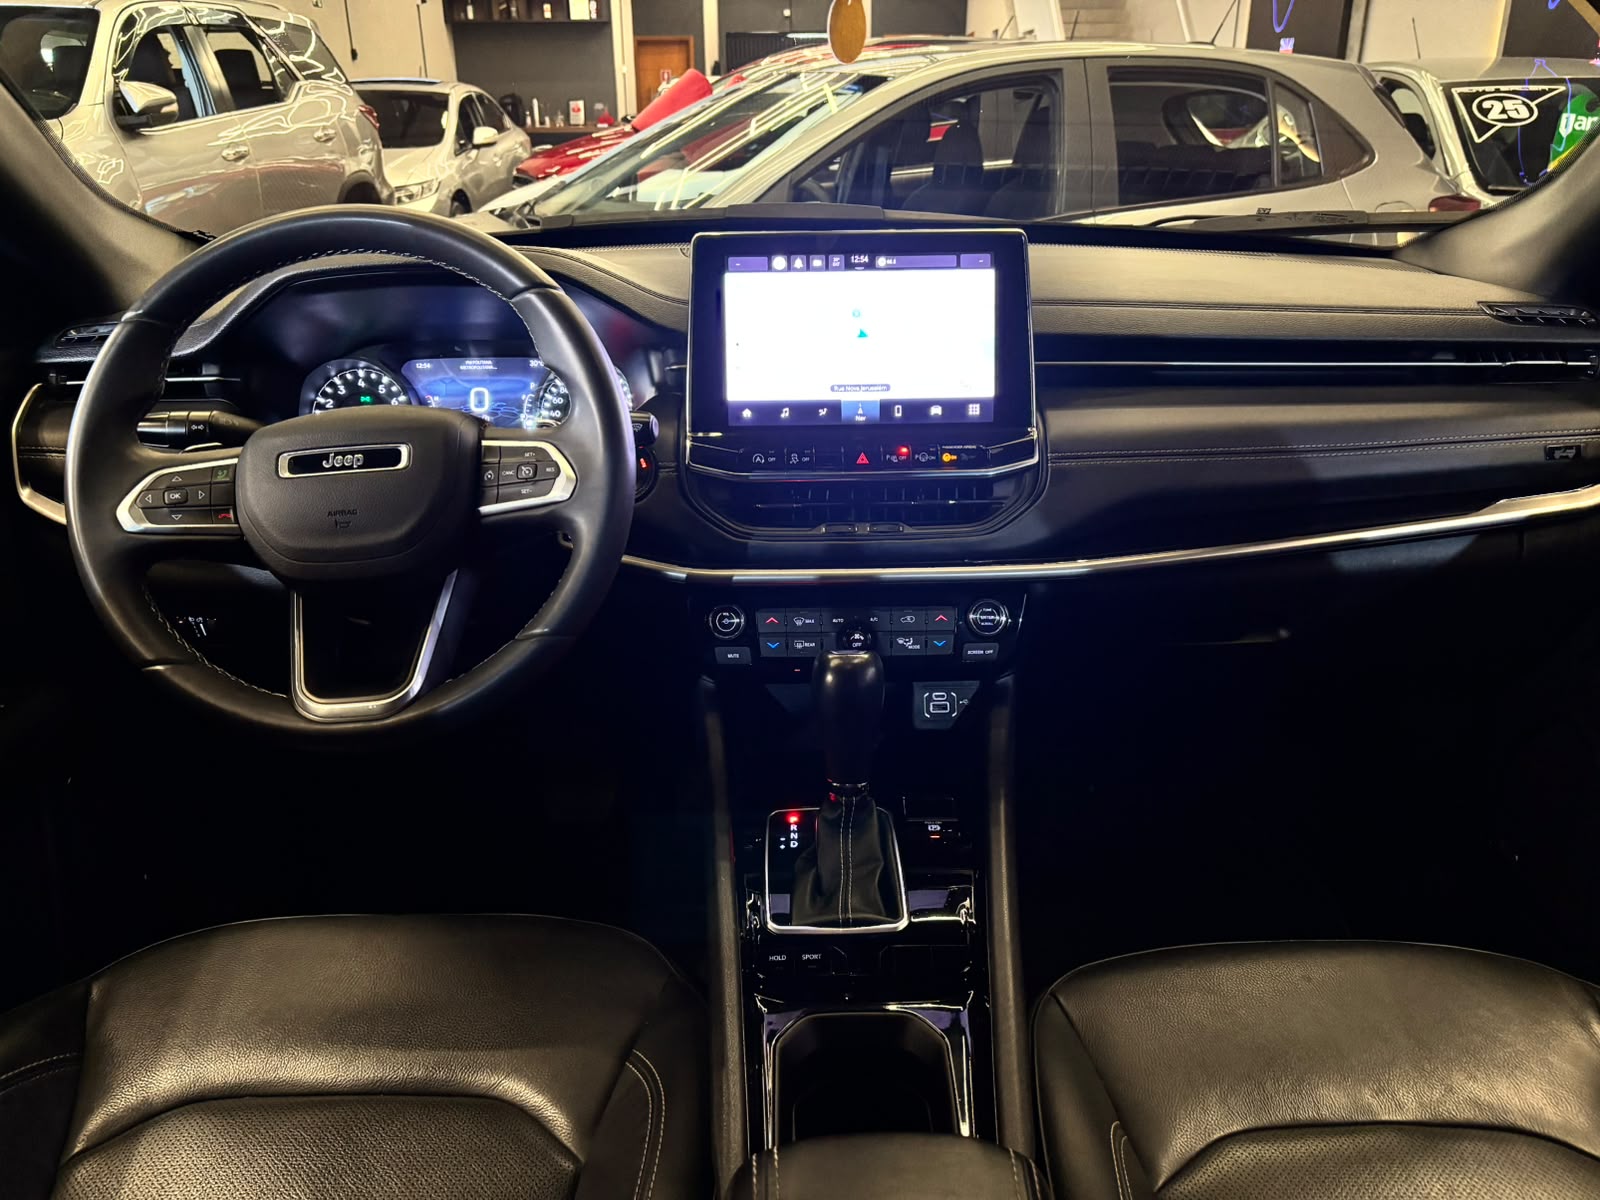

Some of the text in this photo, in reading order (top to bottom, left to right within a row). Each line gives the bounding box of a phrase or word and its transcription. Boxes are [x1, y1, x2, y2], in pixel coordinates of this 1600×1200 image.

[1481, 99, 1530, 120] 25
[851, 255, 868, 263] 12:54
[357, 378, 365, 388] 4
[337, 385, 346, 395] 3
[378, 384, 386, 394] 5
[325, 399, 334, 408] 2
[391, 397, 398, 406] 6
[470, 387, 489, 412] 0
[550, 409, 561, 417] 40
[322, 452, 364, 468] Jeep
[327, 508, 358, 518] AIRBAG
[790, 840, 799, 848] D
